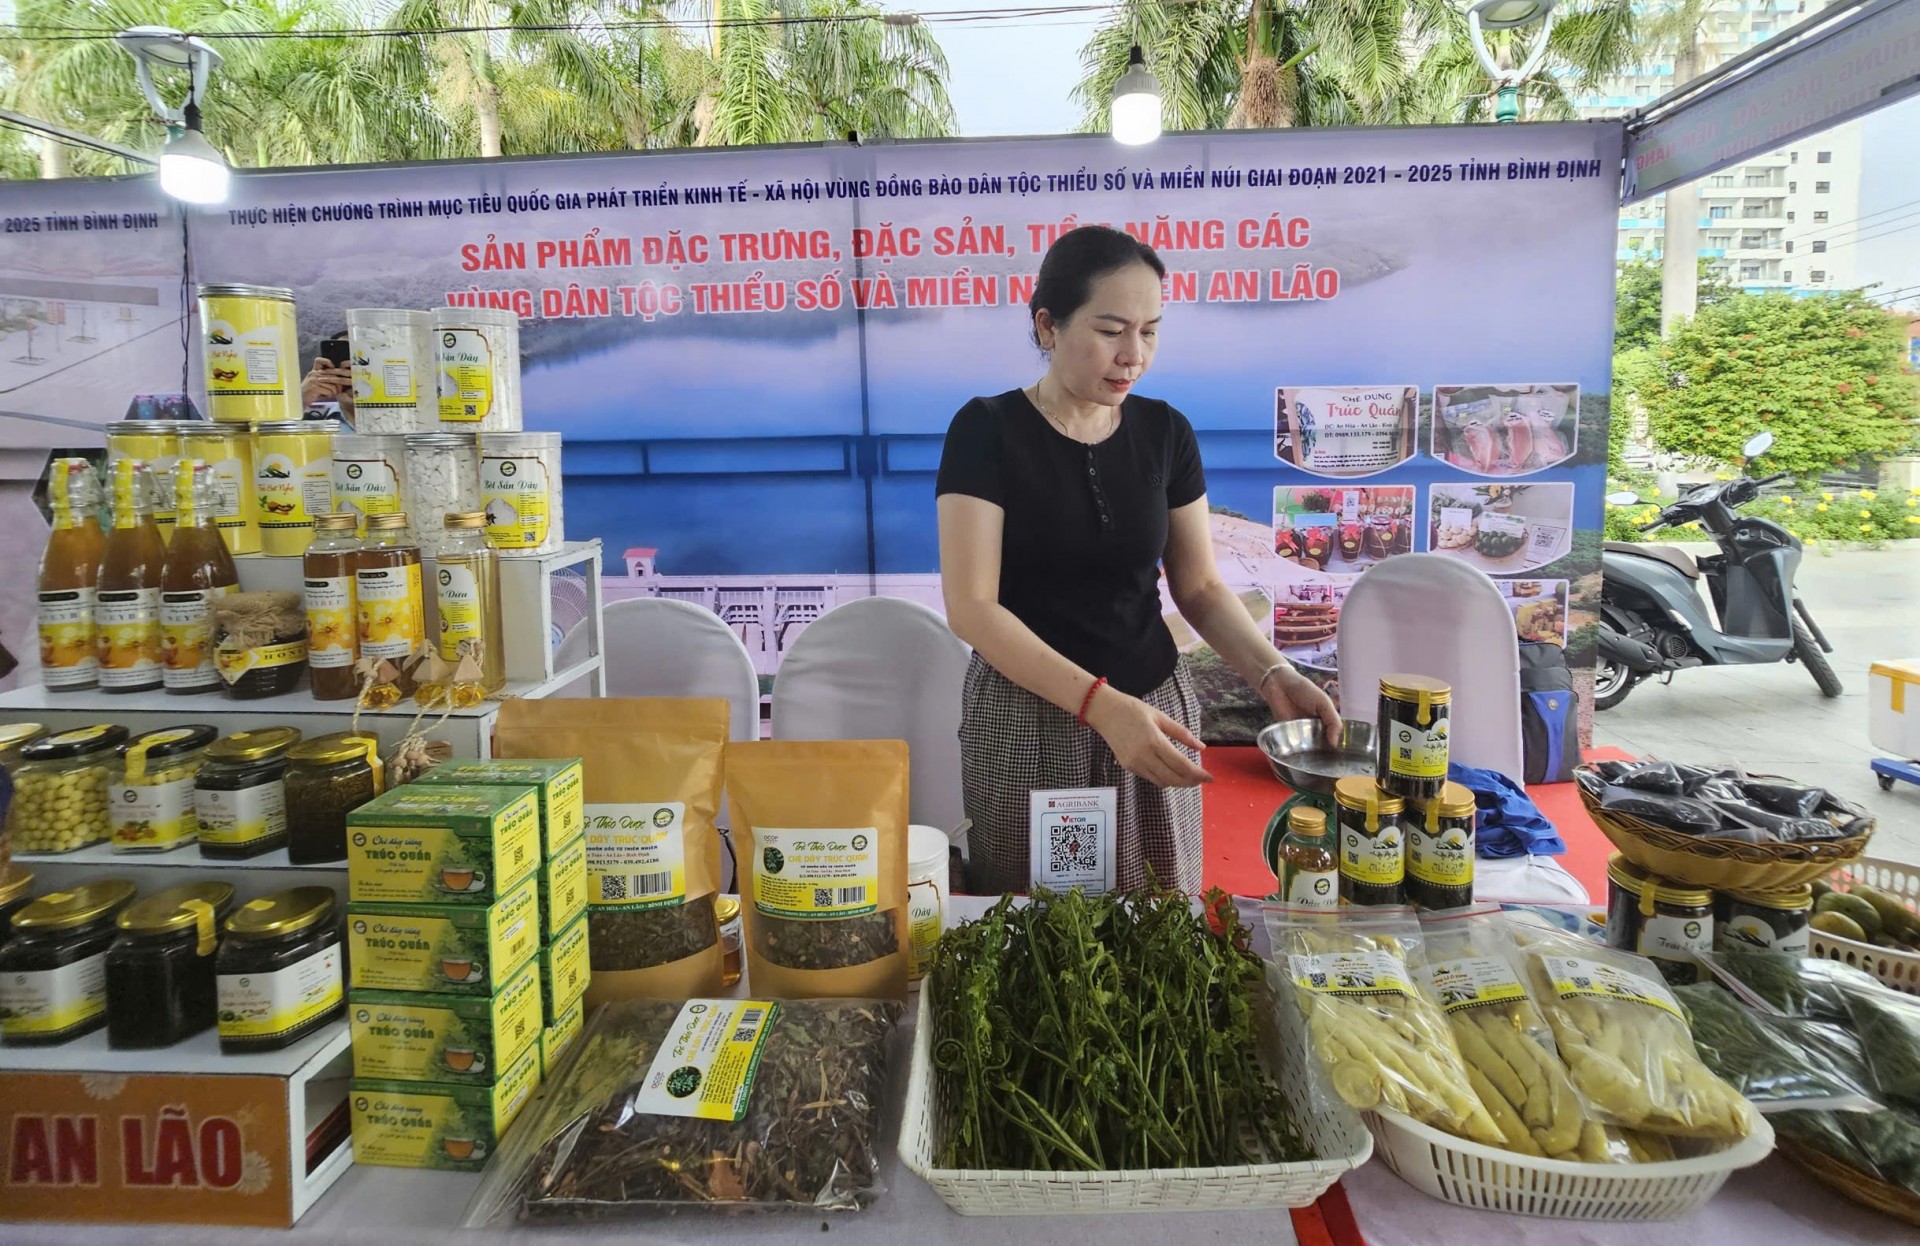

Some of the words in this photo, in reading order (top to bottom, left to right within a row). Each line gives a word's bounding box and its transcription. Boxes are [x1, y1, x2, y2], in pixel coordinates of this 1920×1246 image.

[228, 207, 267, 228] THỰC
[272, 203, 307, 227] HIỆN
[312, 202, 374, 222] CHƯƠNG
[378, 198, 423, 219] TRÌNH
[428, 198, 463, 219] MỤC
[468, 193, 501, 214] TIÊU
[507, 188, 550, 213] QUỐC
[556, 193, 582, 210] GIA
[587, 187, 627, 208] PHÁT
[632, 181, 678, 207] TRIỂN
[684, 186, 722, 205] KINH
[727, 179, 748, 203] TẾ
[764, 180, 786, 201] XÃ
[791, 179, 819, 203] HỘI
[825, 177, 870, 199] VÙNG
[876, 173, 922, 197] ĐỒNG
[928, 174, 962, 196] BÀO
[968, 173, 1001, 195] DÂN
[1008, 171, 1041, 196] TỘC
[1047, 166, 1097, 192] THIỂU
[1103, 166, 1127, 191] SỐ
[1131, 168, 1154, 190] VÀ
[1160, 164, 1205, 189] MIỀN
[1211, 166, 1241, 188] NÚI
[1247, 168, 1282, 187] GIAI
[1288, 167, 1337, 189] ĐOẠN
[1343, 165, 1387, 184] 2021
[1408, 164, 1453, 182] 2025
[1459, 157, 1500, 181] TỈNH
[1507, 157, 1550, 180] BÌNH
[1556, 159, 1601, 182] ĐỊNH
[5, 217, 41, 233] 2025
[83, 210, 118, 230] BÌNH
[123, 212, 158, 232] ĐỊNH
[460, 233, 527, 272] SẢN
[536, 227, 632, 269] PHẨM
[642, 230, 709, 271] ĐẶC
[718, 228, 841, 263] TRƯNG,
[851, 221, 921, 264] ĐẶC
[933, 216, 1015, 259] SẢN,
[1125, 214, 1225, 250] NĂNG
[1237, 212, 1310, 249] CÁC
[542, 282, 611, 318] DÂN
[619, 280, 682, 320] TỘC
[691, 270, 786, 314] THIỂU
[796, 269, 842, 310] SỐ
[851, 272, 897, 308] VÀ
[907, 267, 997, 306] MIỀN
[1207, 270, 1258, 301] AN
[1271, 264, 1339, 299] LÃO
[1326, 402, 1362, 418] Trúc
[1057, 800, 1100, 808] AGRIBANK
[365, 848, 396, 860] TRÚC
[9, 1114, 98, 1187] AN
[121, 1104, 243, 1189] LÃO
